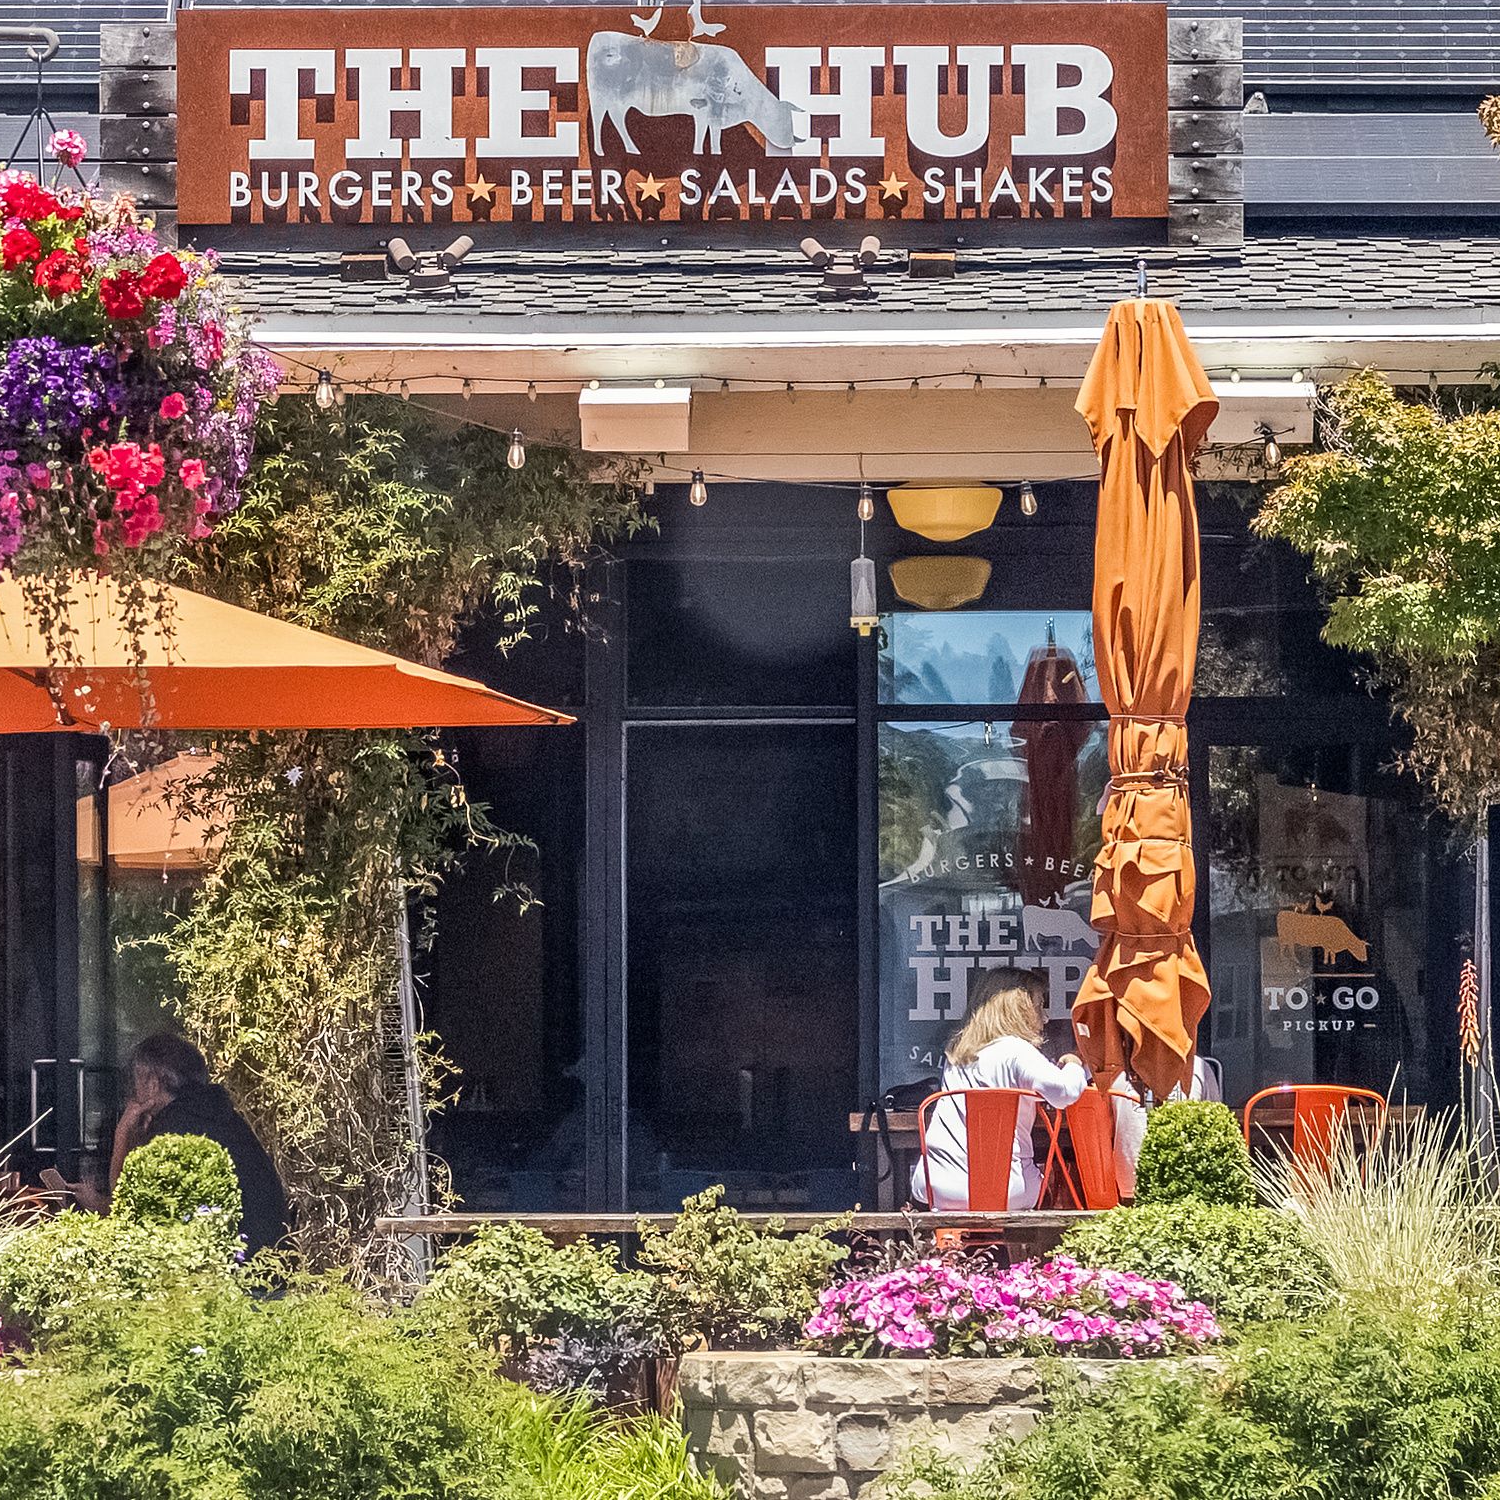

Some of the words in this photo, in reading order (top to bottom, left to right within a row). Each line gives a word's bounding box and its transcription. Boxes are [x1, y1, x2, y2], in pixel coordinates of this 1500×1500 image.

[229, 47, 580, 159] THE
[765, 44, 1118, 158] HUB
[229, 169, 455, 208] BURGERS
[511, 168, 625, 207] BEER
[679, 166, 868, 205] SALADS
[923, 165, 1114, 204] SHAKES
[908, 852, 1014, 884] BURGERS
[910, 915, 1018, 951] THE
[908, 956, 1094, 1021] HB
[1263, 986, 1309, 1011] TO
[1332, 986, 1379, 1010] GO
[1283, 1020, 1356, 1031] PICKUP
[909, 1045, 944, 1069] SAL
